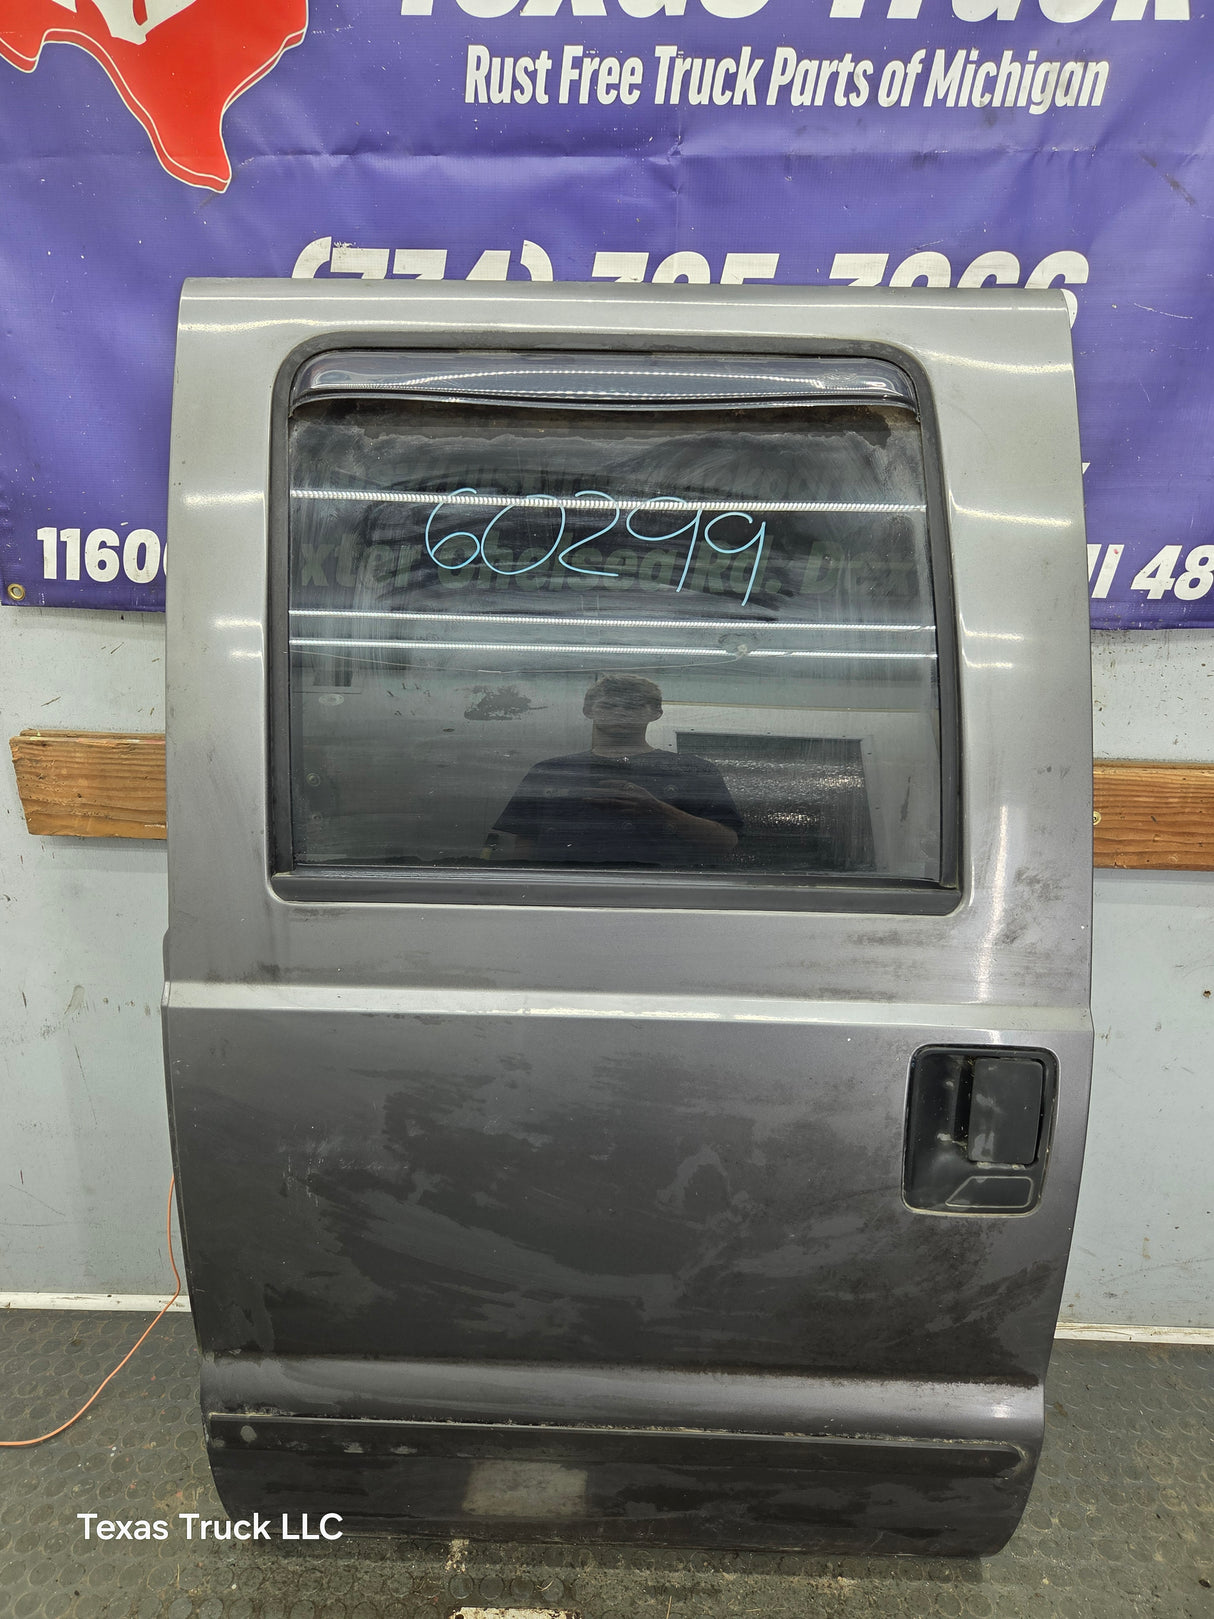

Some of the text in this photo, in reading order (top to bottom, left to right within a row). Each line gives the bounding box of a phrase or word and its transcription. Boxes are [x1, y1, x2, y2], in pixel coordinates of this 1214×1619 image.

[465, 45, 1110, 115] Rust Free Truck Parts of Michigan
[36, 527, 167, 584] 1160
[301, 534, 420, 588] xter
[425, 487, 767, 606] 60299
